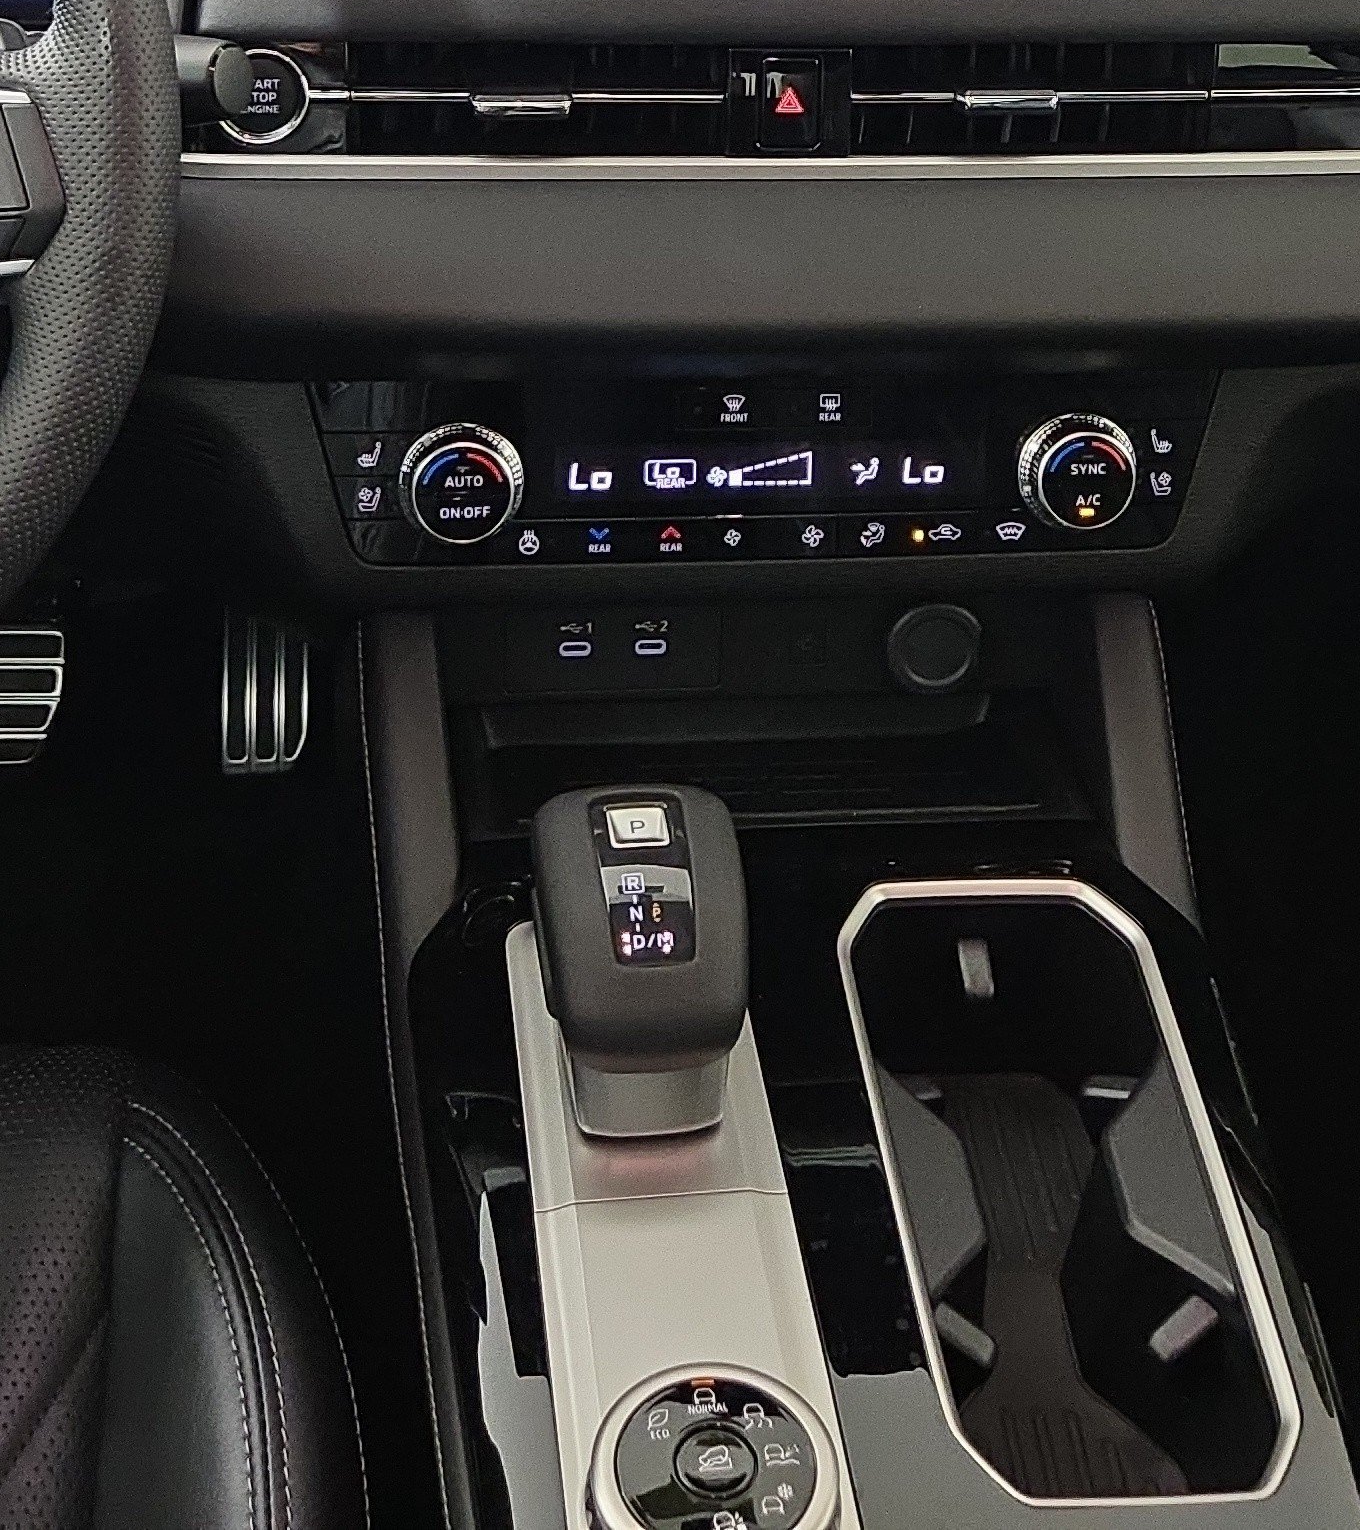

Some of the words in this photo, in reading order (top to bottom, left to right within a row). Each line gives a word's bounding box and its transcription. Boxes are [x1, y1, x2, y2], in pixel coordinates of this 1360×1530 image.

[253, 78, 281, 90] ART
[251, 91, 277, 103] TOP
[720, 412, 748, 422] FRONT
[819, 412, 841, 421] REAR
[652, 461, 681, 478] Lo
[902, 456, 945, 484] Lo
[1070, 463, 1107, 475] SYNC
[444, 475, 484, 488] AUTO
[568, 462, 613, 490] Lo
[656, 477, 686, 489] REAR
[1075, 494, 1101, 506] A/C
[588, 543, 611, 553] REAR
[659, 542, 682, 552] REAR
[586, 622, 592, 633] 1
[660, 620, 668, 632] 2
[629, 820, 646, 834] P
[627, 876, 640, 890] R
[629, 905, 644, 921] N
[632, 932, 674, 951] D/M
[687, 1400, 729, 1415] NORMAL
[649, 1428, 670, 1440] ECO
